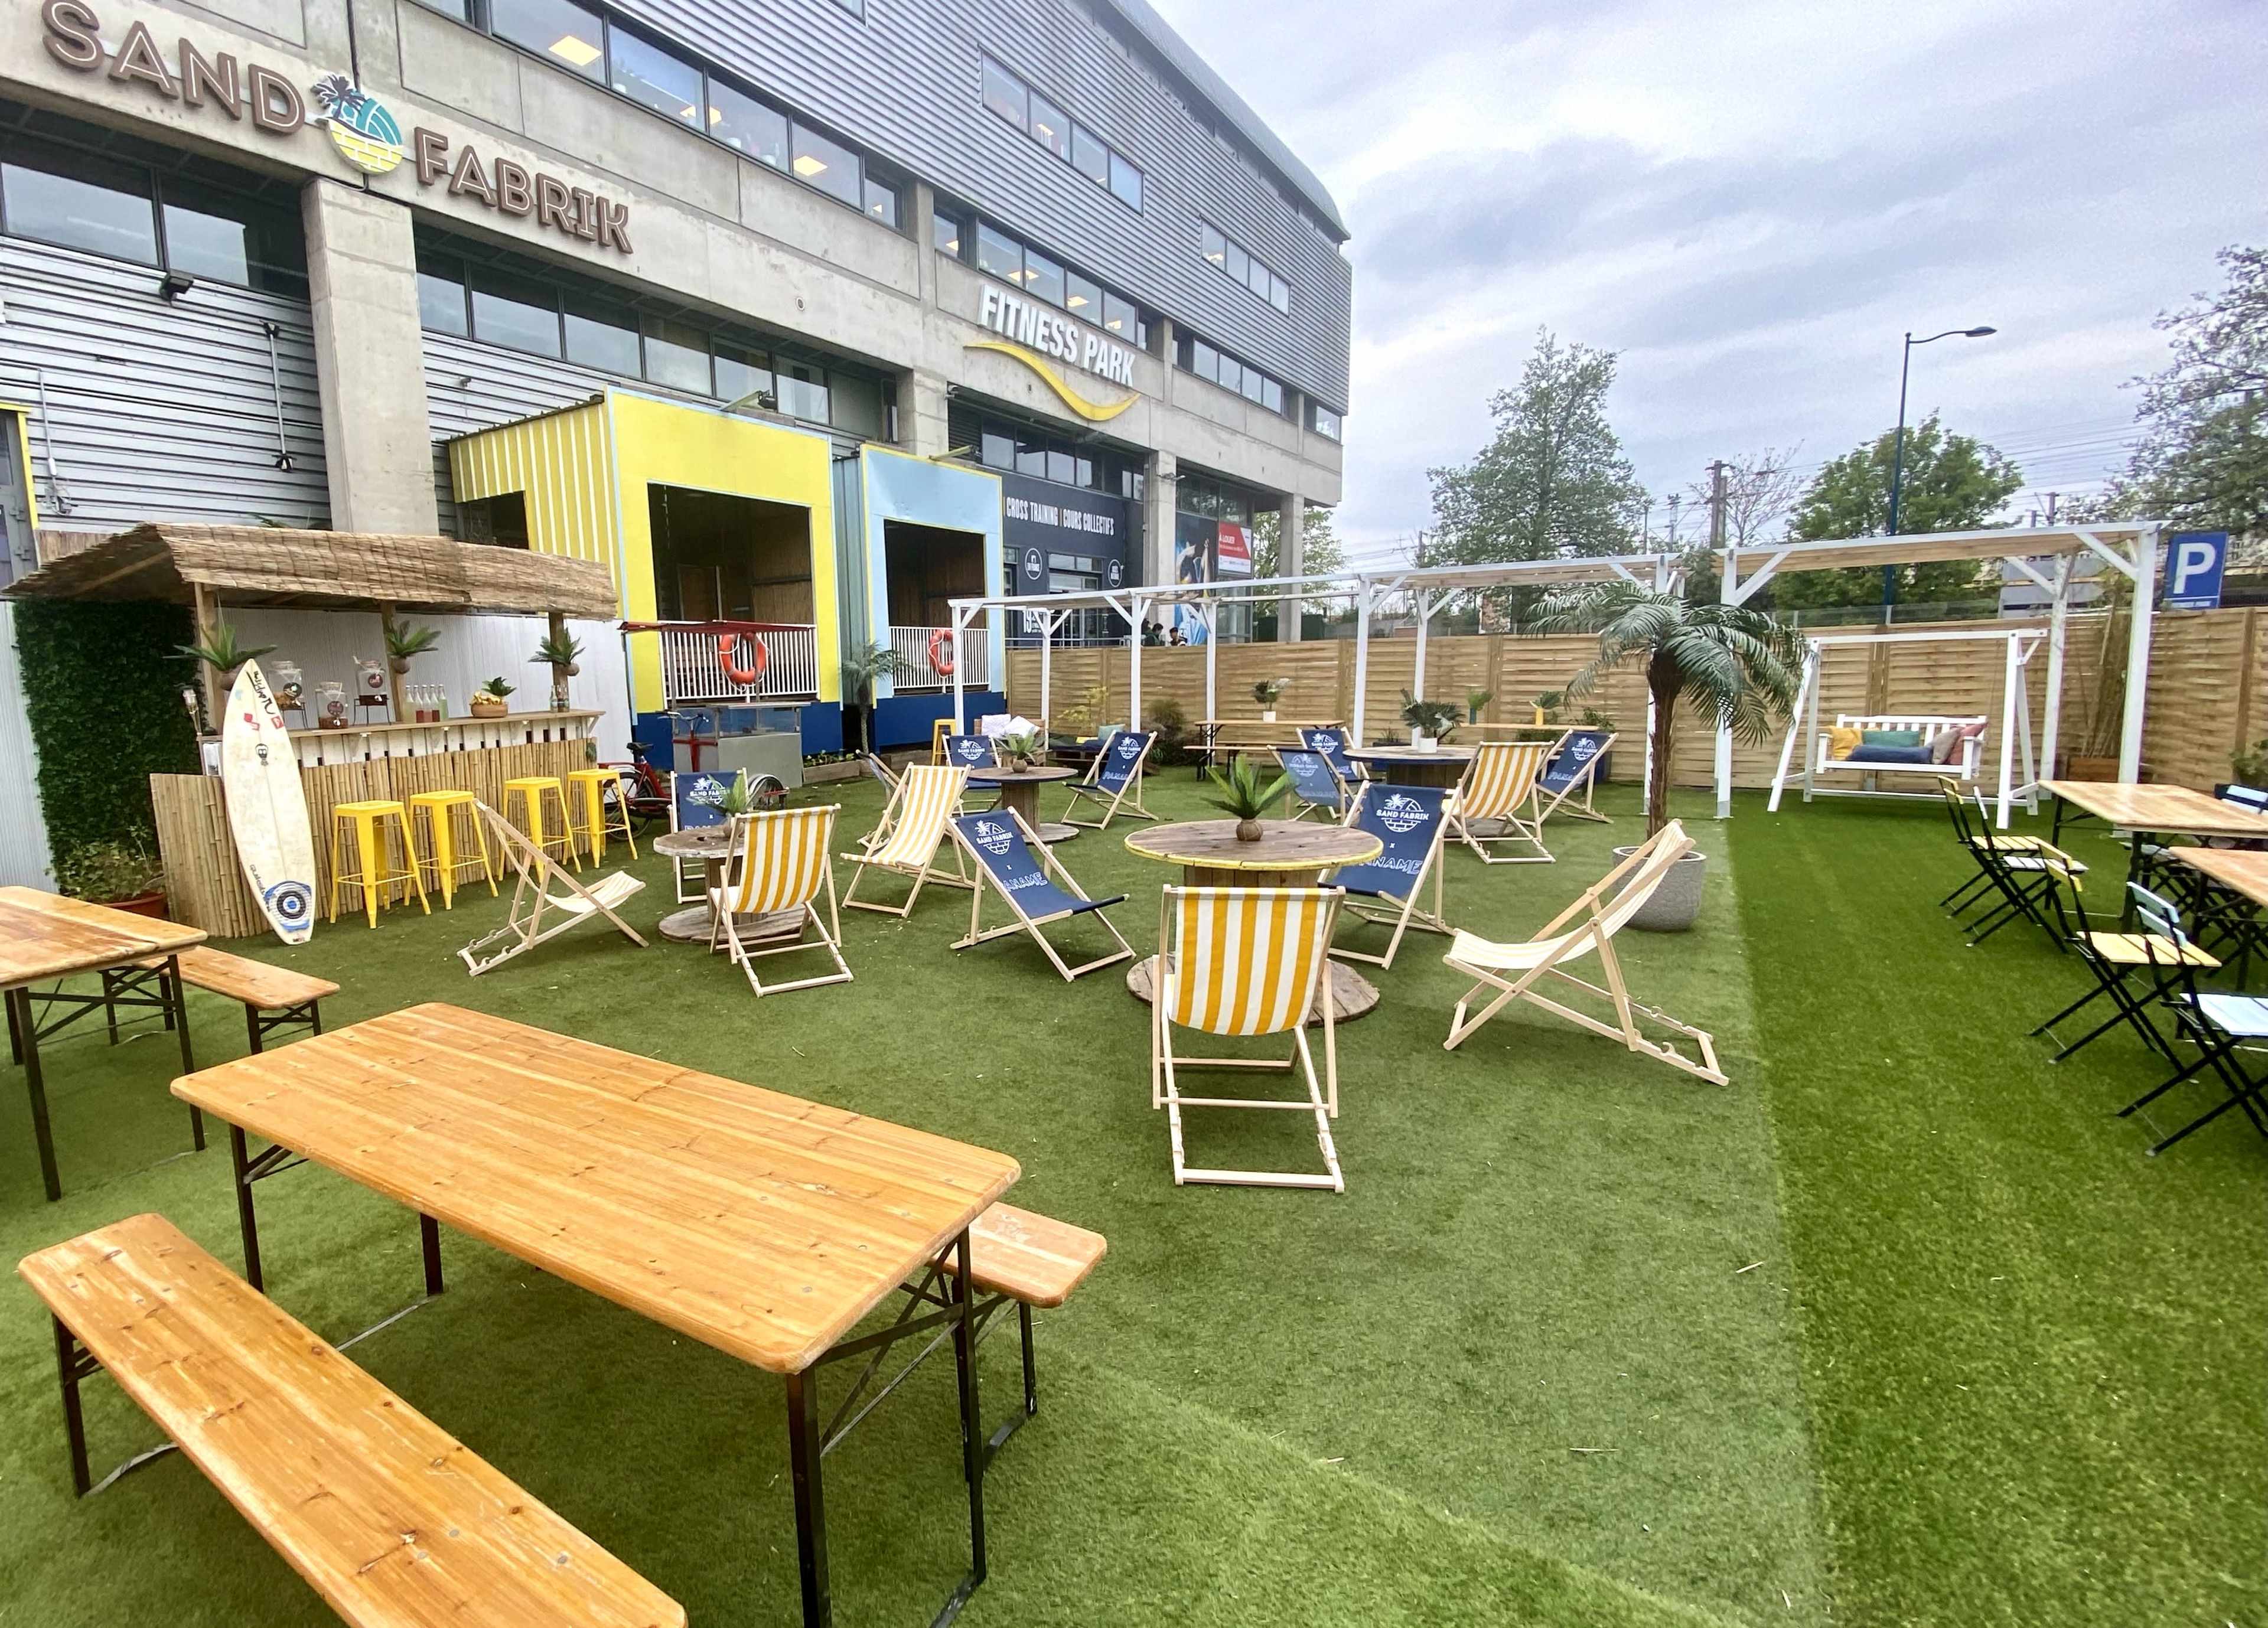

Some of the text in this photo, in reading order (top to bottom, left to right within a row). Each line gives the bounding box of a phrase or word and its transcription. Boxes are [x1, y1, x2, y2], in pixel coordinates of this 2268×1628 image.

[41, 0, 634, 255] SAND FABRIK
[977, 283, 1136, 387] FITNESS PARK
[1006, 497, 1114, 536] CROSS TRAINING COURS COLLECTIFS
[2173, 542, 2215, 594] P
[1376, 809, 1430, 821] SAND FABRIK
[976, 831, 1014, 844] SAND FABRIK
[1003, 872, 1048, 892] ANAME
